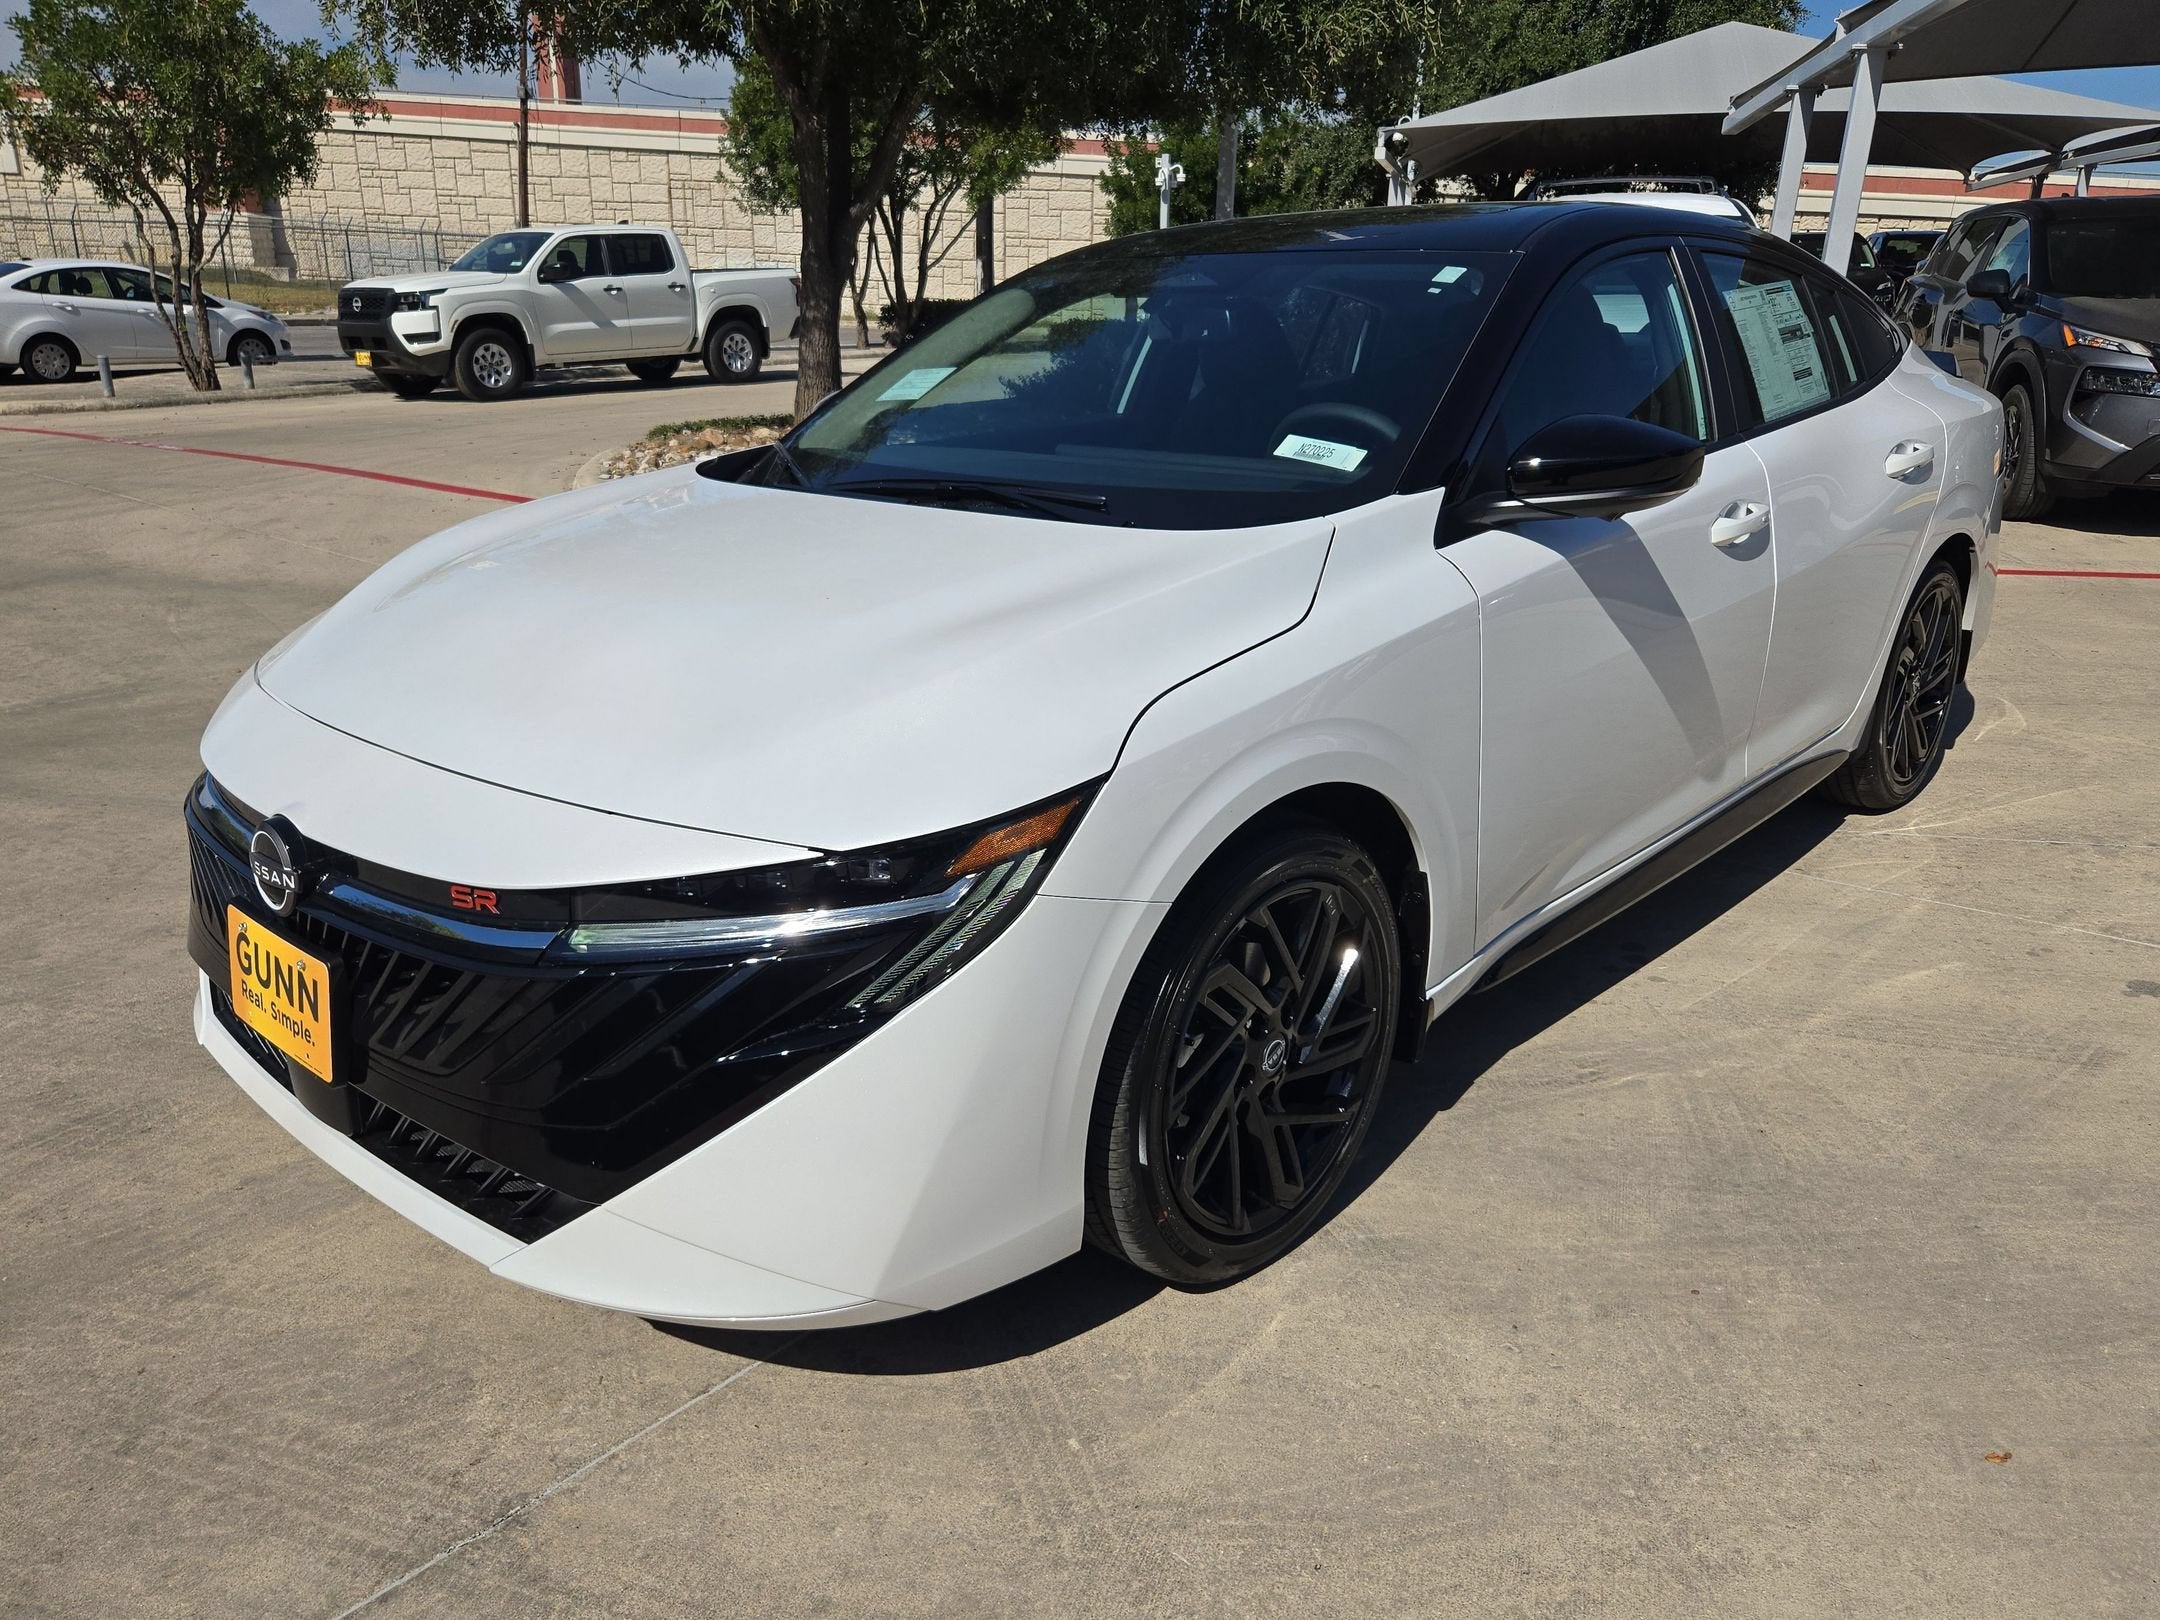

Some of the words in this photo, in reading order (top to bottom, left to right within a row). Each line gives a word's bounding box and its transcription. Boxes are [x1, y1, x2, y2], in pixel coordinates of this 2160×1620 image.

[1297, 442, 1336, 459] N270225
[253, 860, 296, 889] SSAN
[450, 885, 501, 915] SR
[236, 931, 320, 1024] GUNN
[241, 978, 267, 1014] Real.
[270, 1001, 316, 1048] Simple.
